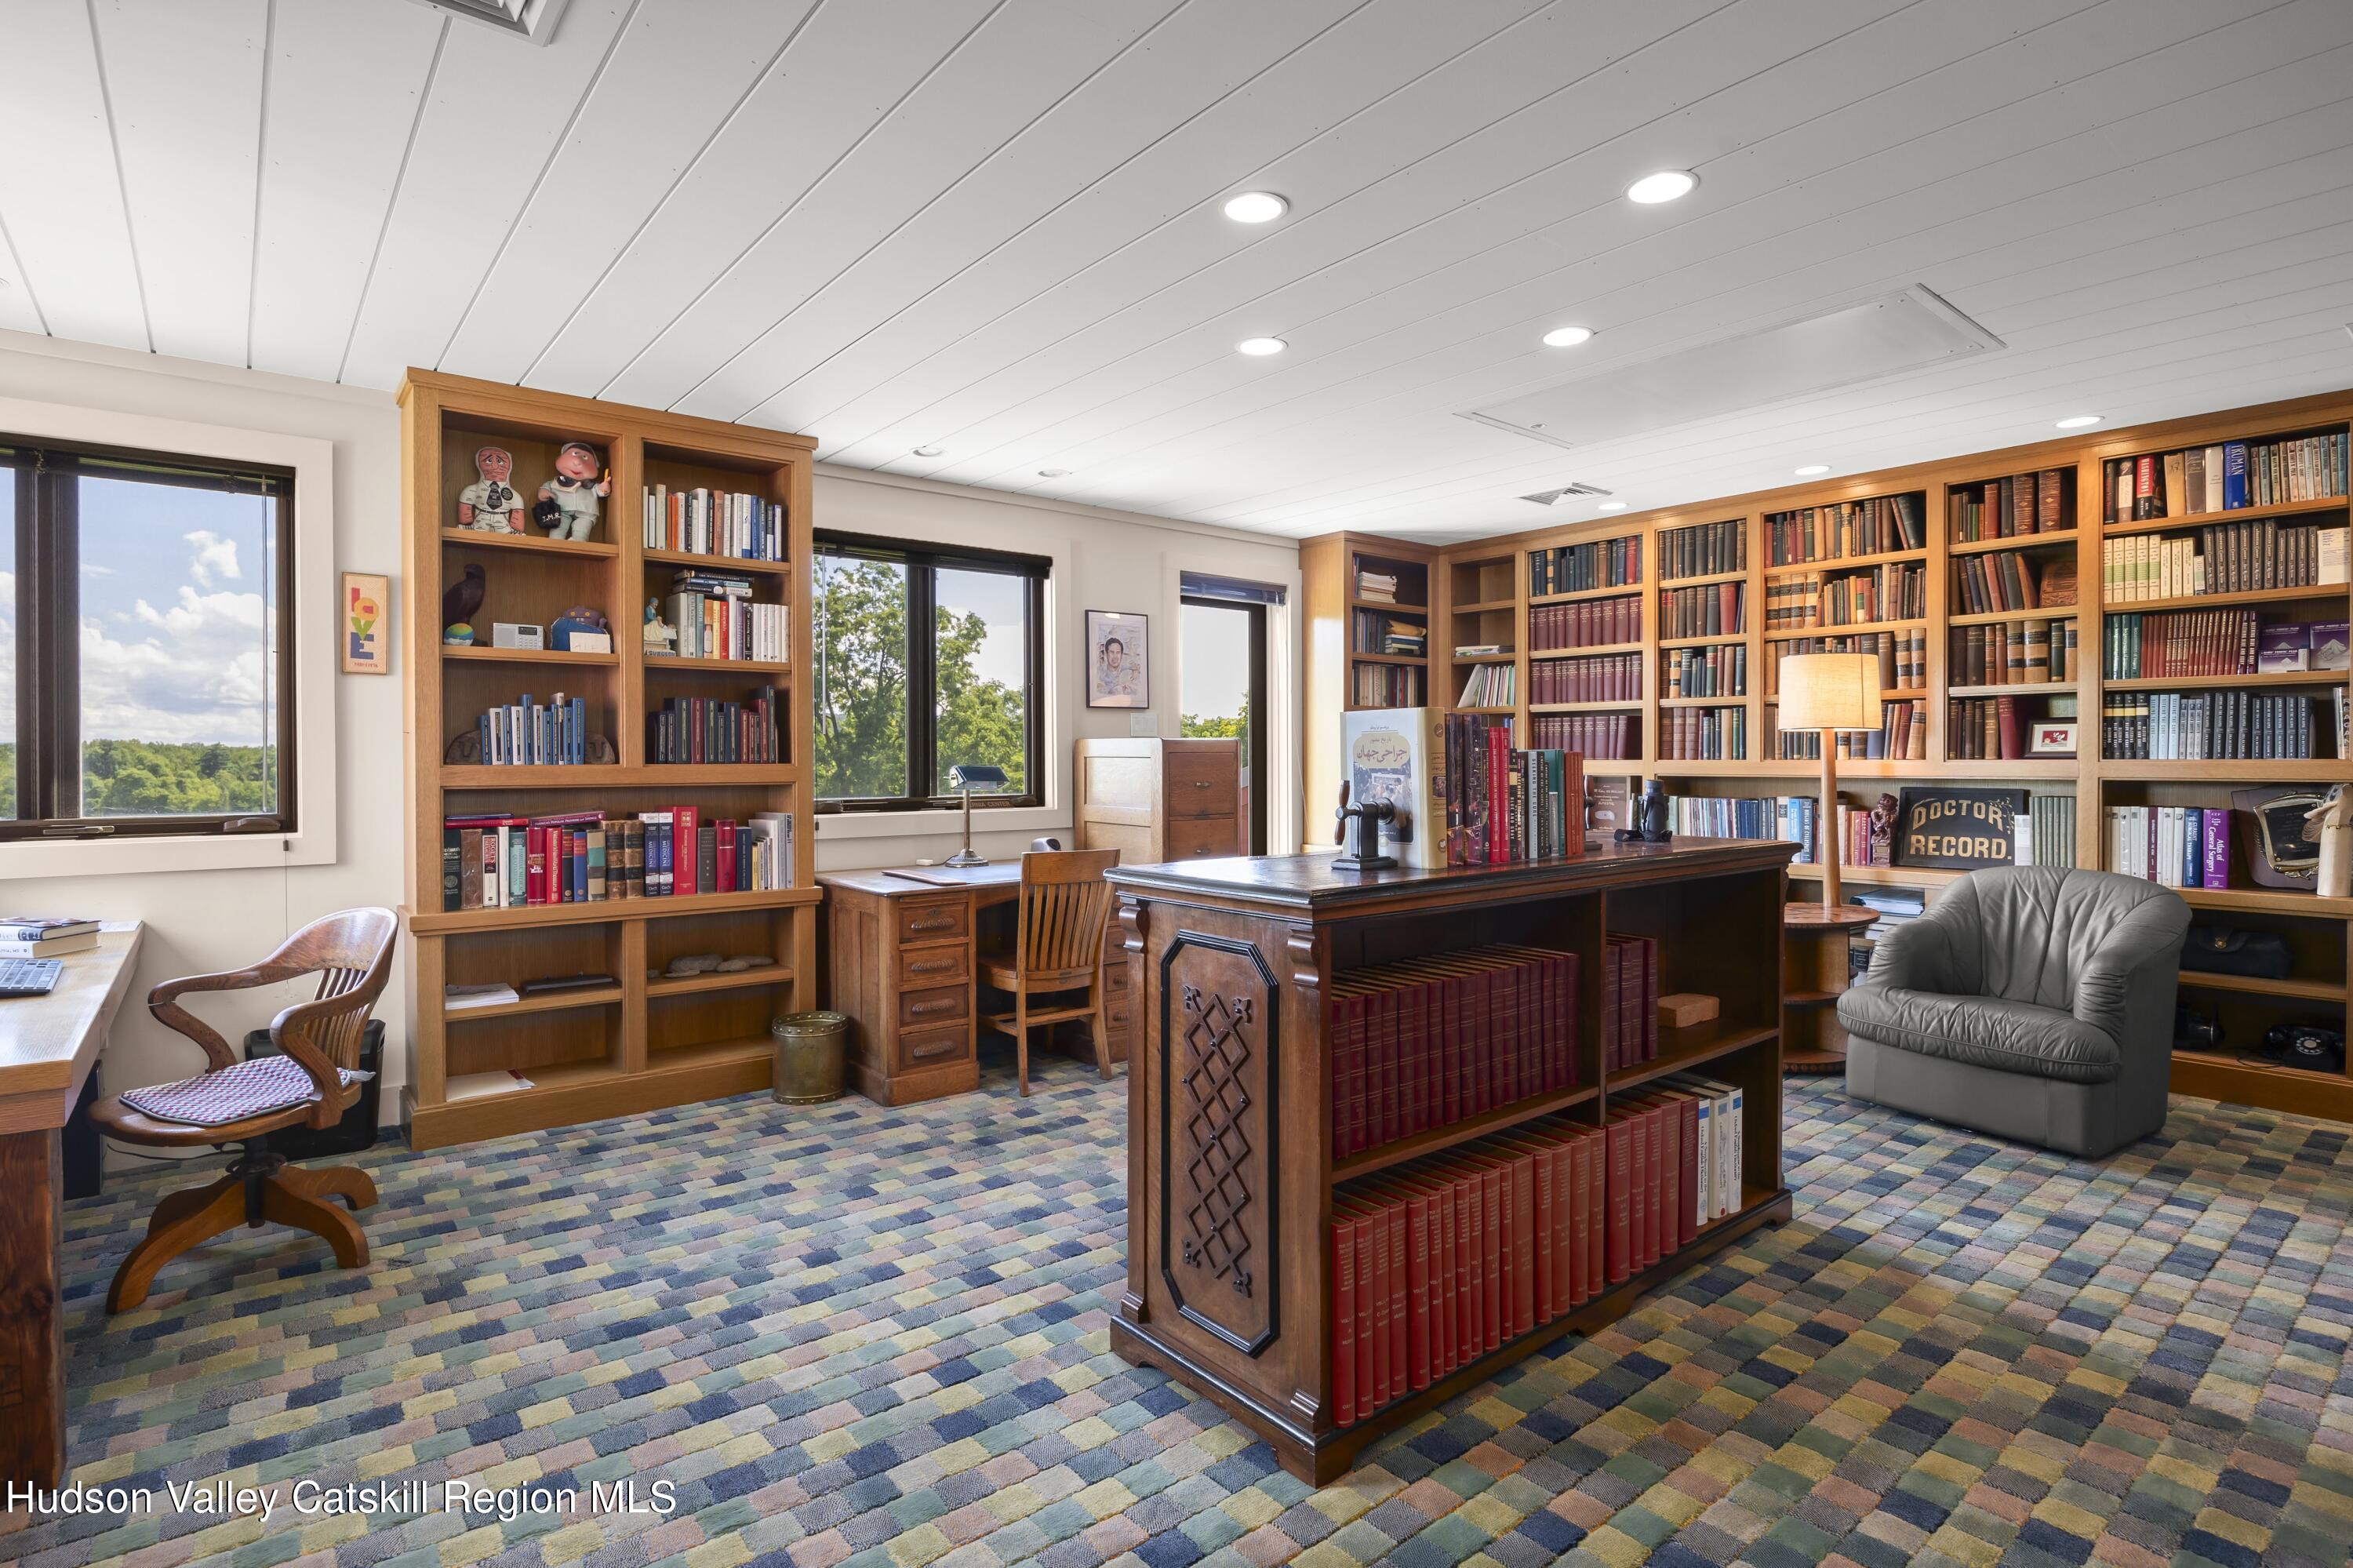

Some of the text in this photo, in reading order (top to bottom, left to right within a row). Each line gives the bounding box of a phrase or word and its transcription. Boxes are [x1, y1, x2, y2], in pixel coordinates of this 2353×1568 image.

[2140, 457, 2150, 493] WASHINGTON
[2231, 445, 2246, 476] TRUMAN
[1912, 799, 2003, 832] DOCTOR
[1909, 834, 2013, 860] RECORD.
[2206, 827, 2217, 873] General Surgery
[2216, 839, 2225, 854] Atlas
